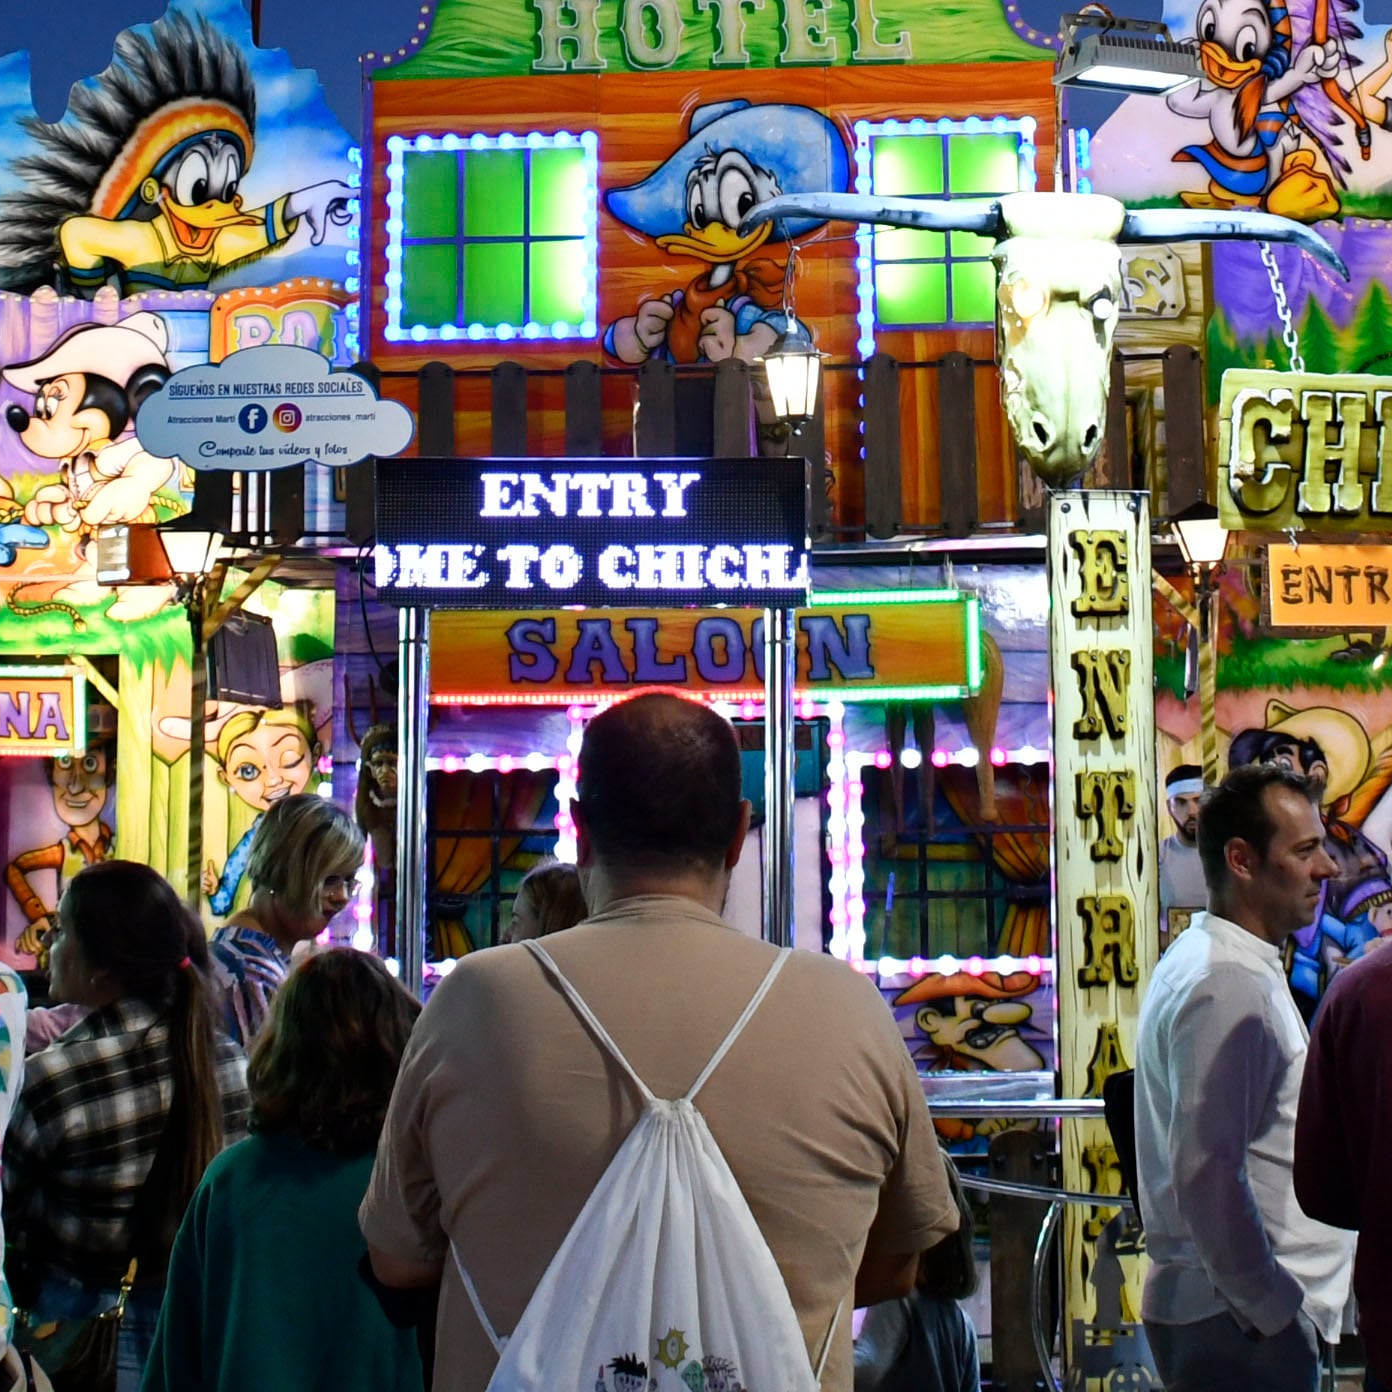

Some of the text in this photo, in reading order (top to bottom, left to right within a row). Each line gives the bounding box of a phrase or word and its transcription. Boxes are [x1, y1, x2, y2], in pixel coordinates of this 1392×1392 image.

[218, 384, 230, 395] EN
[233, 382, 282, 395] NUESTRAS
[285, 382, 314, 394] REDES
[318, 381, 363, 394] SOCIALES
[198, 441, 256, 459] Comparte
[259, 445, 275, 455] tus
[314, 446, 321, 458] y
[480, 473, 700, 517] ENTRY
[497, 544, 583, 588] TO
